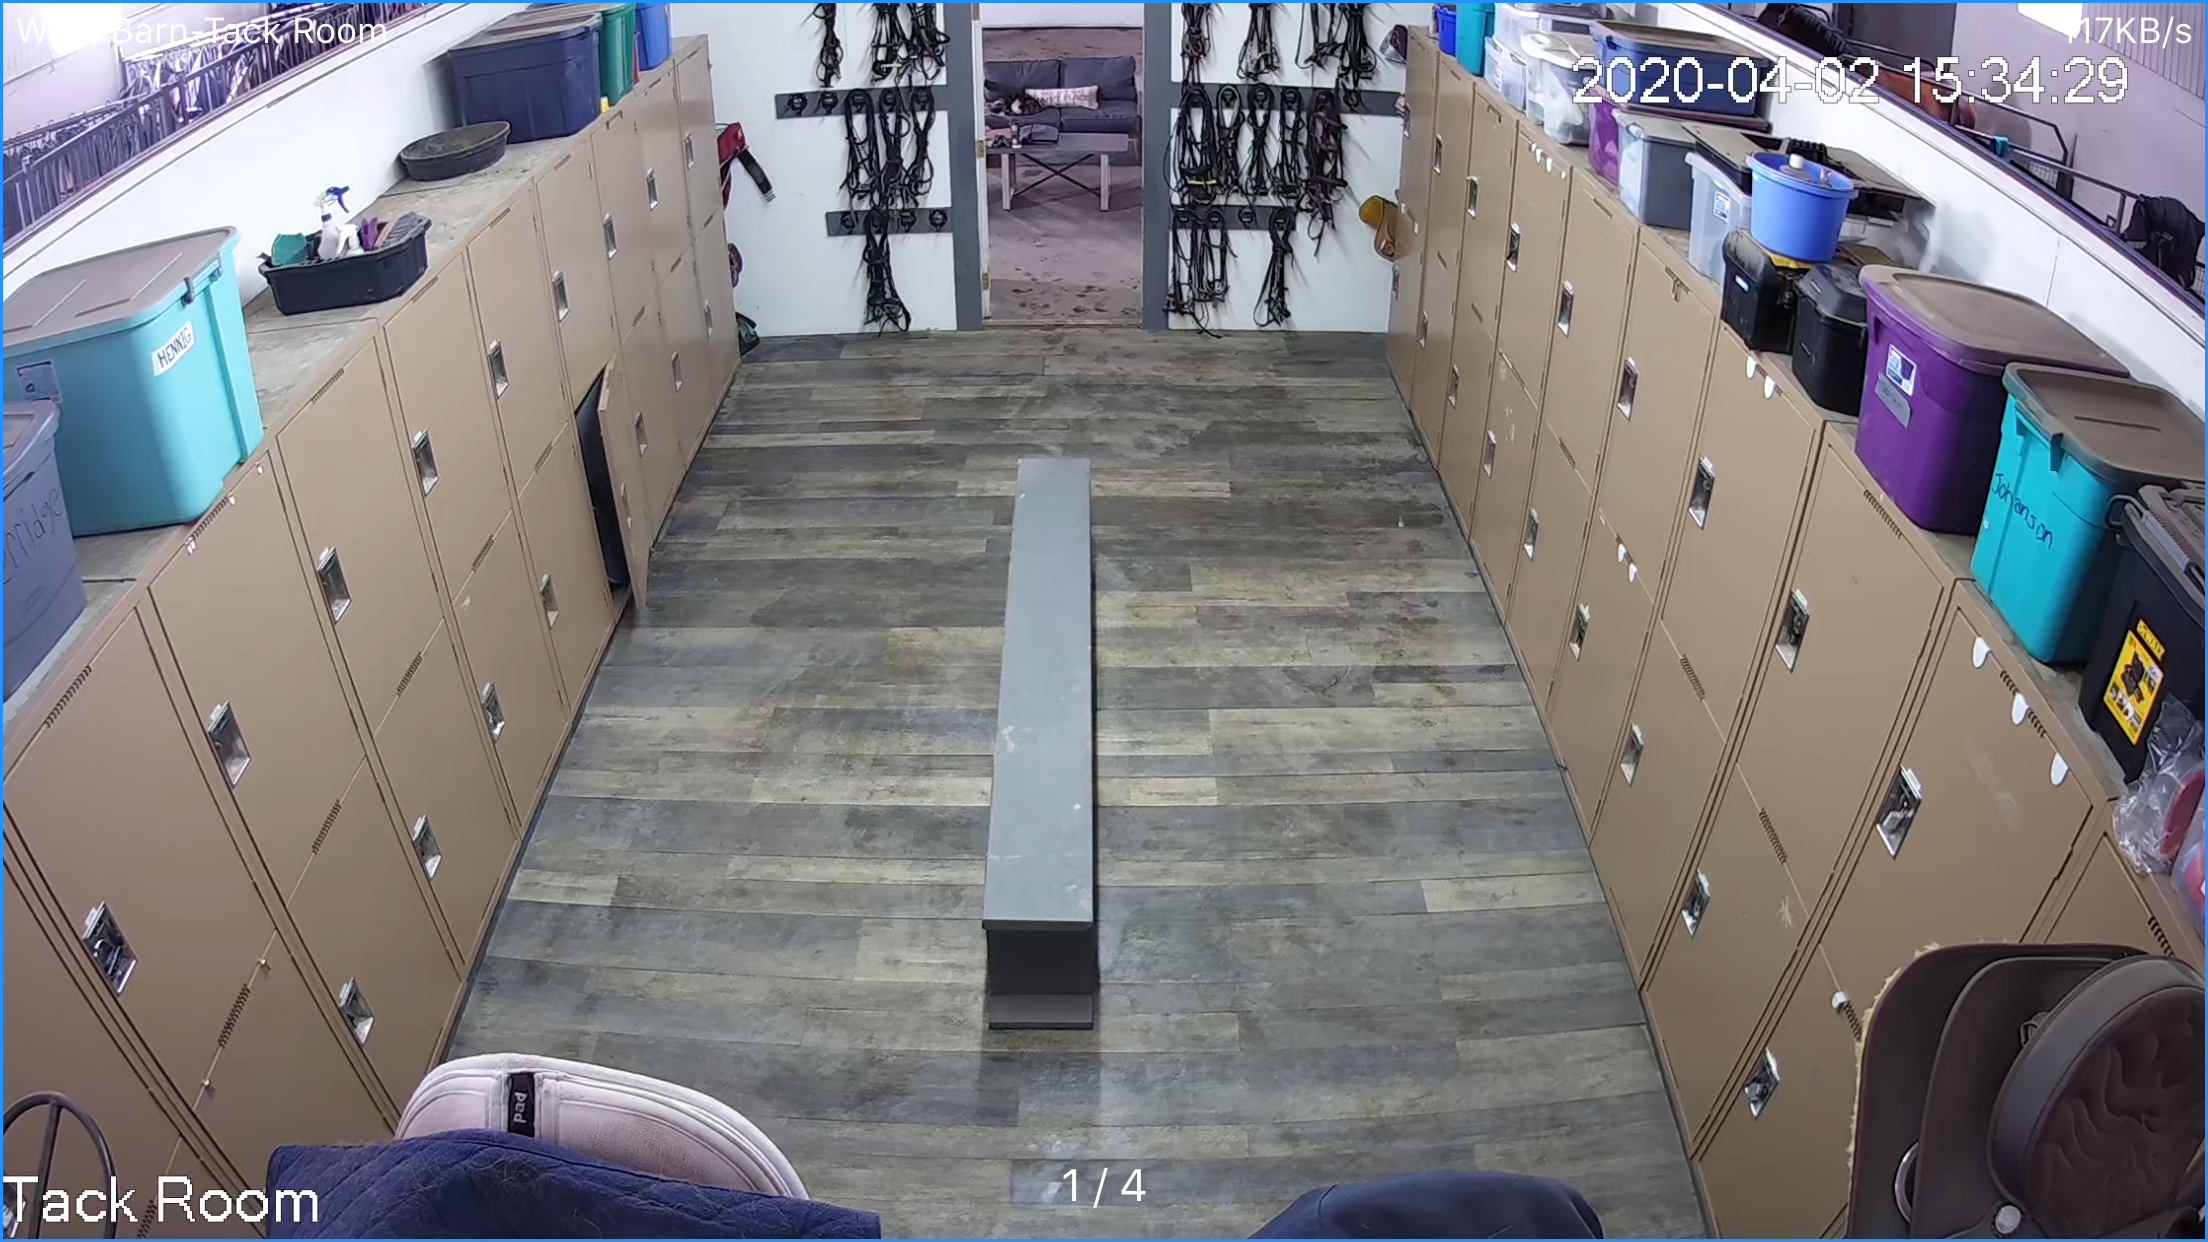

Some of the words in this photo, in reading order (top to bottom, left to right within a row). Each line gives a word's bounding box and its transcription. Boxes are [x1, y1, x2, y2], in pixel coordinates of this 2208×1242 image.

[156, 326, 192, 369] HENNIG
[1991, 473, 2053, 550] Johanson
[512, 1091, 529, 1124] pad
